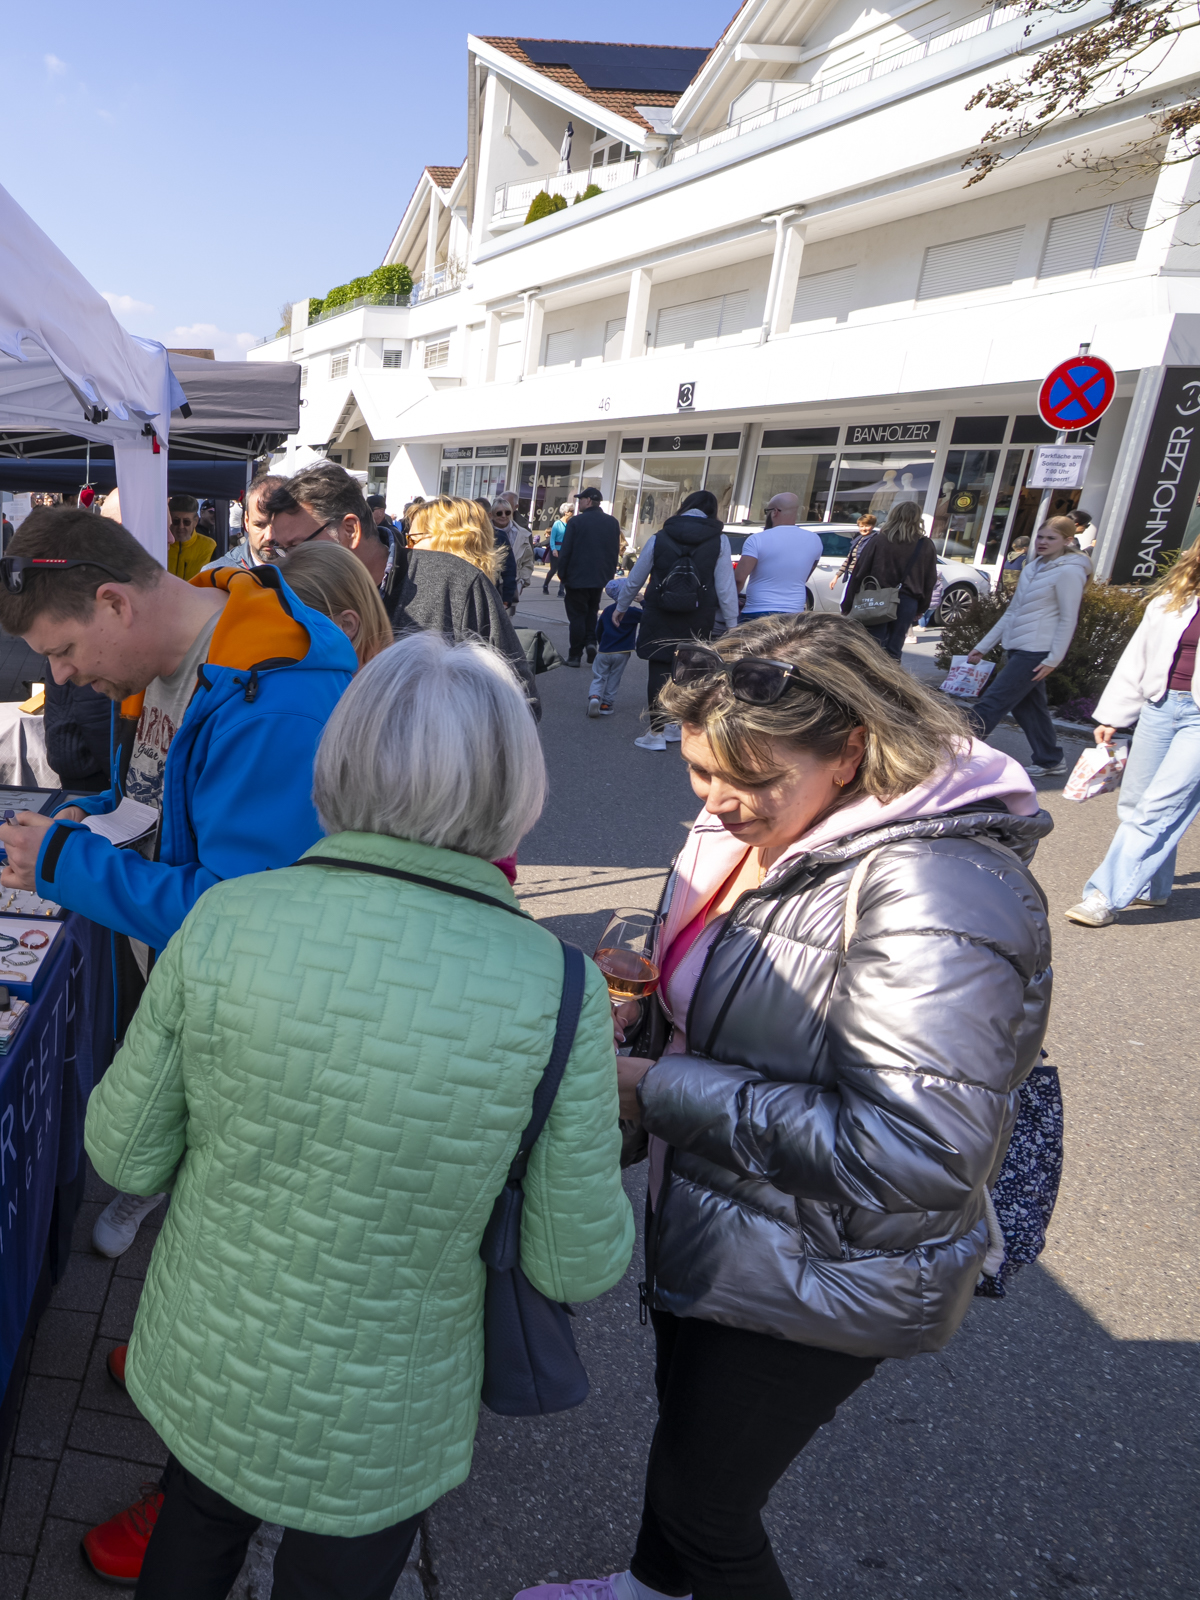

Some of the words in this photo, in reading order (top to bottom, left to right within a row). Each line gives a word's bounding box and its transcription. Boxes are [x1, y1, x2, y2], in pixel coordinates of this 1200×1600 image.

[598, 397, 611, 411] 46
[853, 424, 931, 443] BANHOLZER
[544, 442, 579, 454] BANHOLZER
[528, 475, 561, 488] SALE
[1132, 426, 1194, 577] BANHOLZER
